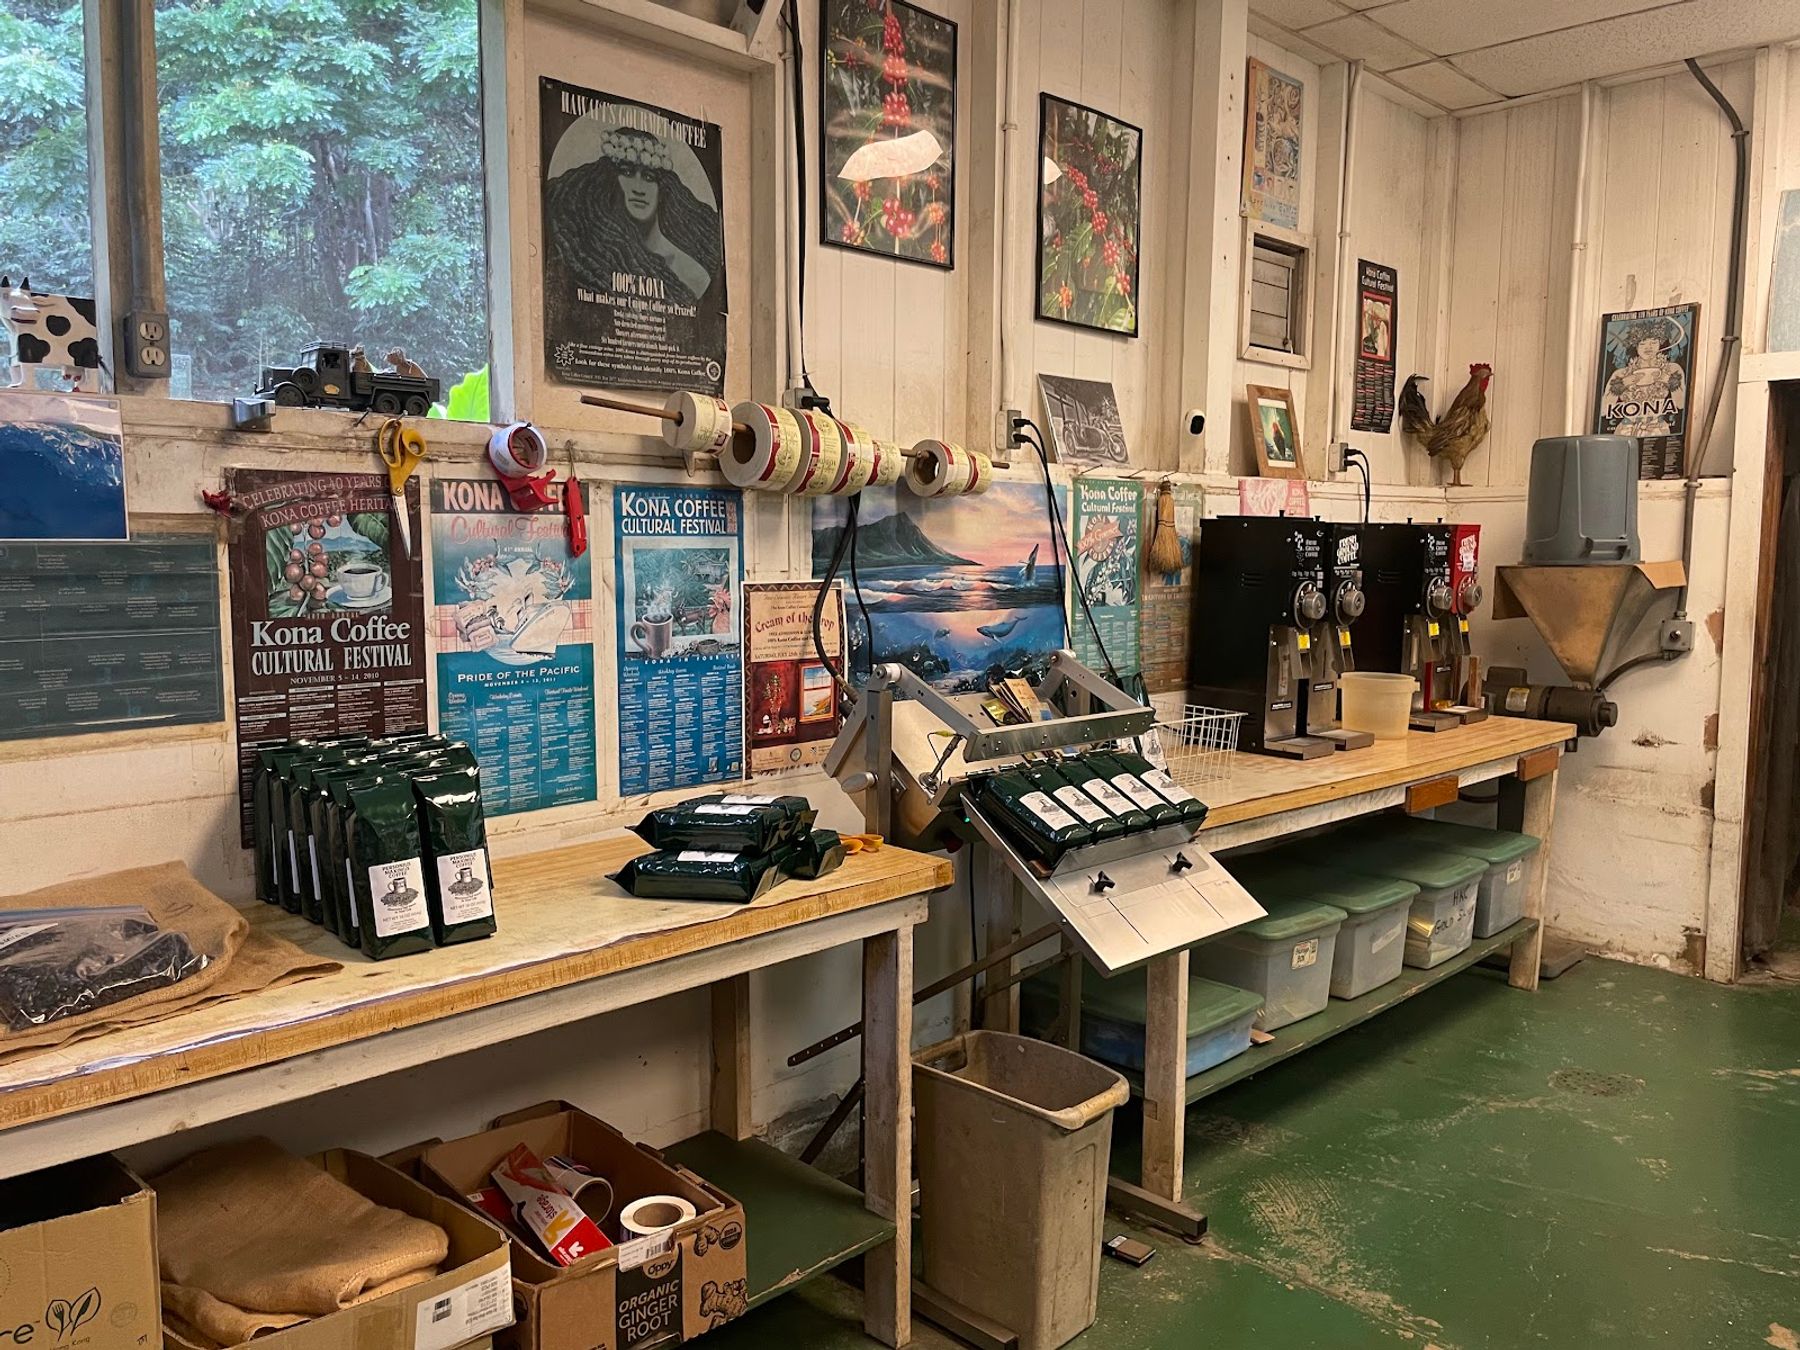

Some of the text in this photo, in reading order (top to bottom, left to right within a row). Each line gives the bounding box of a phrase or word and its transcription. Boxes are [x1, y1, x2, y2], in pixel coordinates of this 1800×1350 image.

[619, 107, 669, 138] GOURMET
[671, 120, 706, 149] COFFEE
[612, 271, 665, 299] 100% KONA
[1606, 398, 1678, 419] KONA
[242, 479, 331, 510] CELEBRATING
[330, 477, 344, 491] 40
[347, 476, 382, 489] YEARS
[443, 481, 504, 511] KONA
[621, 492, 726, 518] KONA COFFEE
[1080, 485, 1106, 501] Kona
[1107, 486, 1138, 502] Coffee
[260, 496, 393, 528] KONA COFFEE HERITA
[621, 518, 727, 534] CULTURAL FESTIVAL
[450, 516, 570, 544] Cultural Festiva
[250, 615, 411, 647] Kona Coffee
[755, 615, 784, 633] Cream
[786, 612, 795, 623] of
[798, 611, 813, 624] the
[252, 643, 412, 676] CULTURAL FESTIVAL
[290, 675, 336, 685] NOVEMBER
[364, 672, 379, 680] 2010
[457, 666, 580, 683] PRIDE OF THE PACIFIC
[484, 680, 518, 688] NOVEMBER
[619, 1280, 680, 1313] ORGANIC
[618, 1294, 679, 1329] GINGER
[627, 1311, 671, 1343] ROOT
